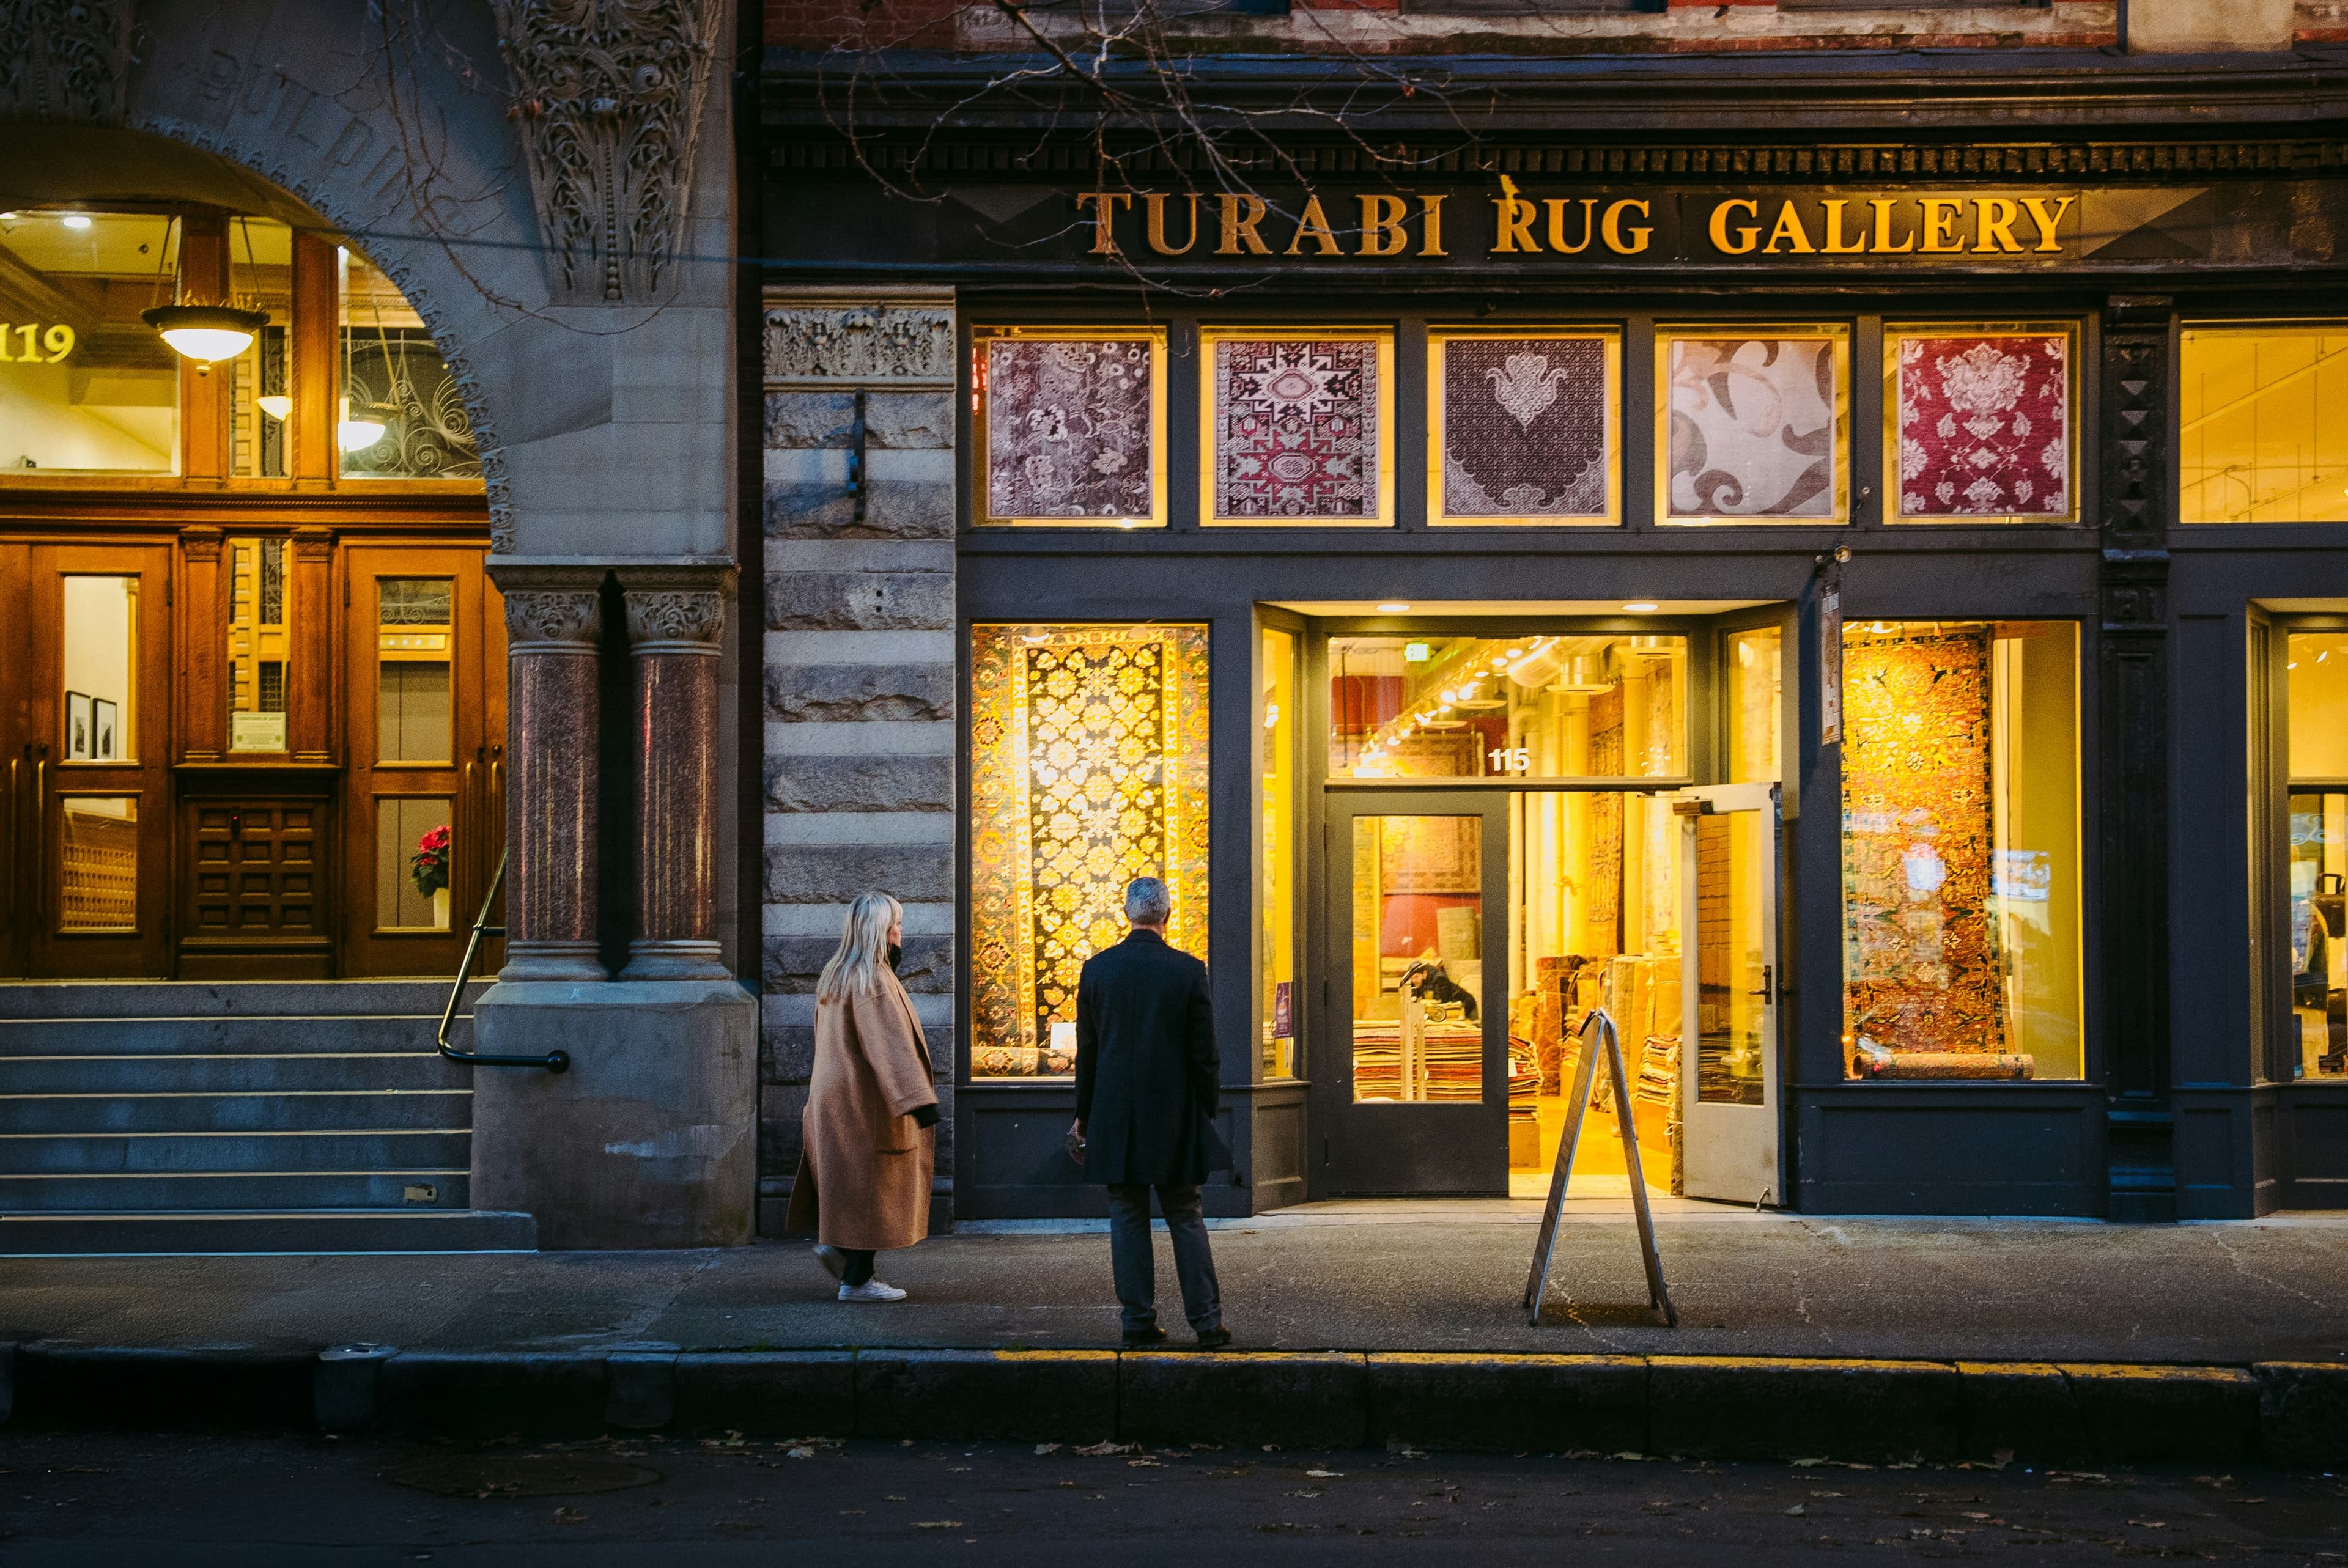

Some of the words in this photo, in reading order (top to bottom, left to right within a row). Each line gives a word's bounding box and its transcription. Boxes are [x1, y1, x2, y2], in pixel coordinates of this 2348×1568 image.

[1077, 193, 1449, 256] TURABI
[1490, 198, 1655, 255] RUG
[1708, 197, 2075, 254] GALLERY
[1488, 748, 1530, 771] 115
